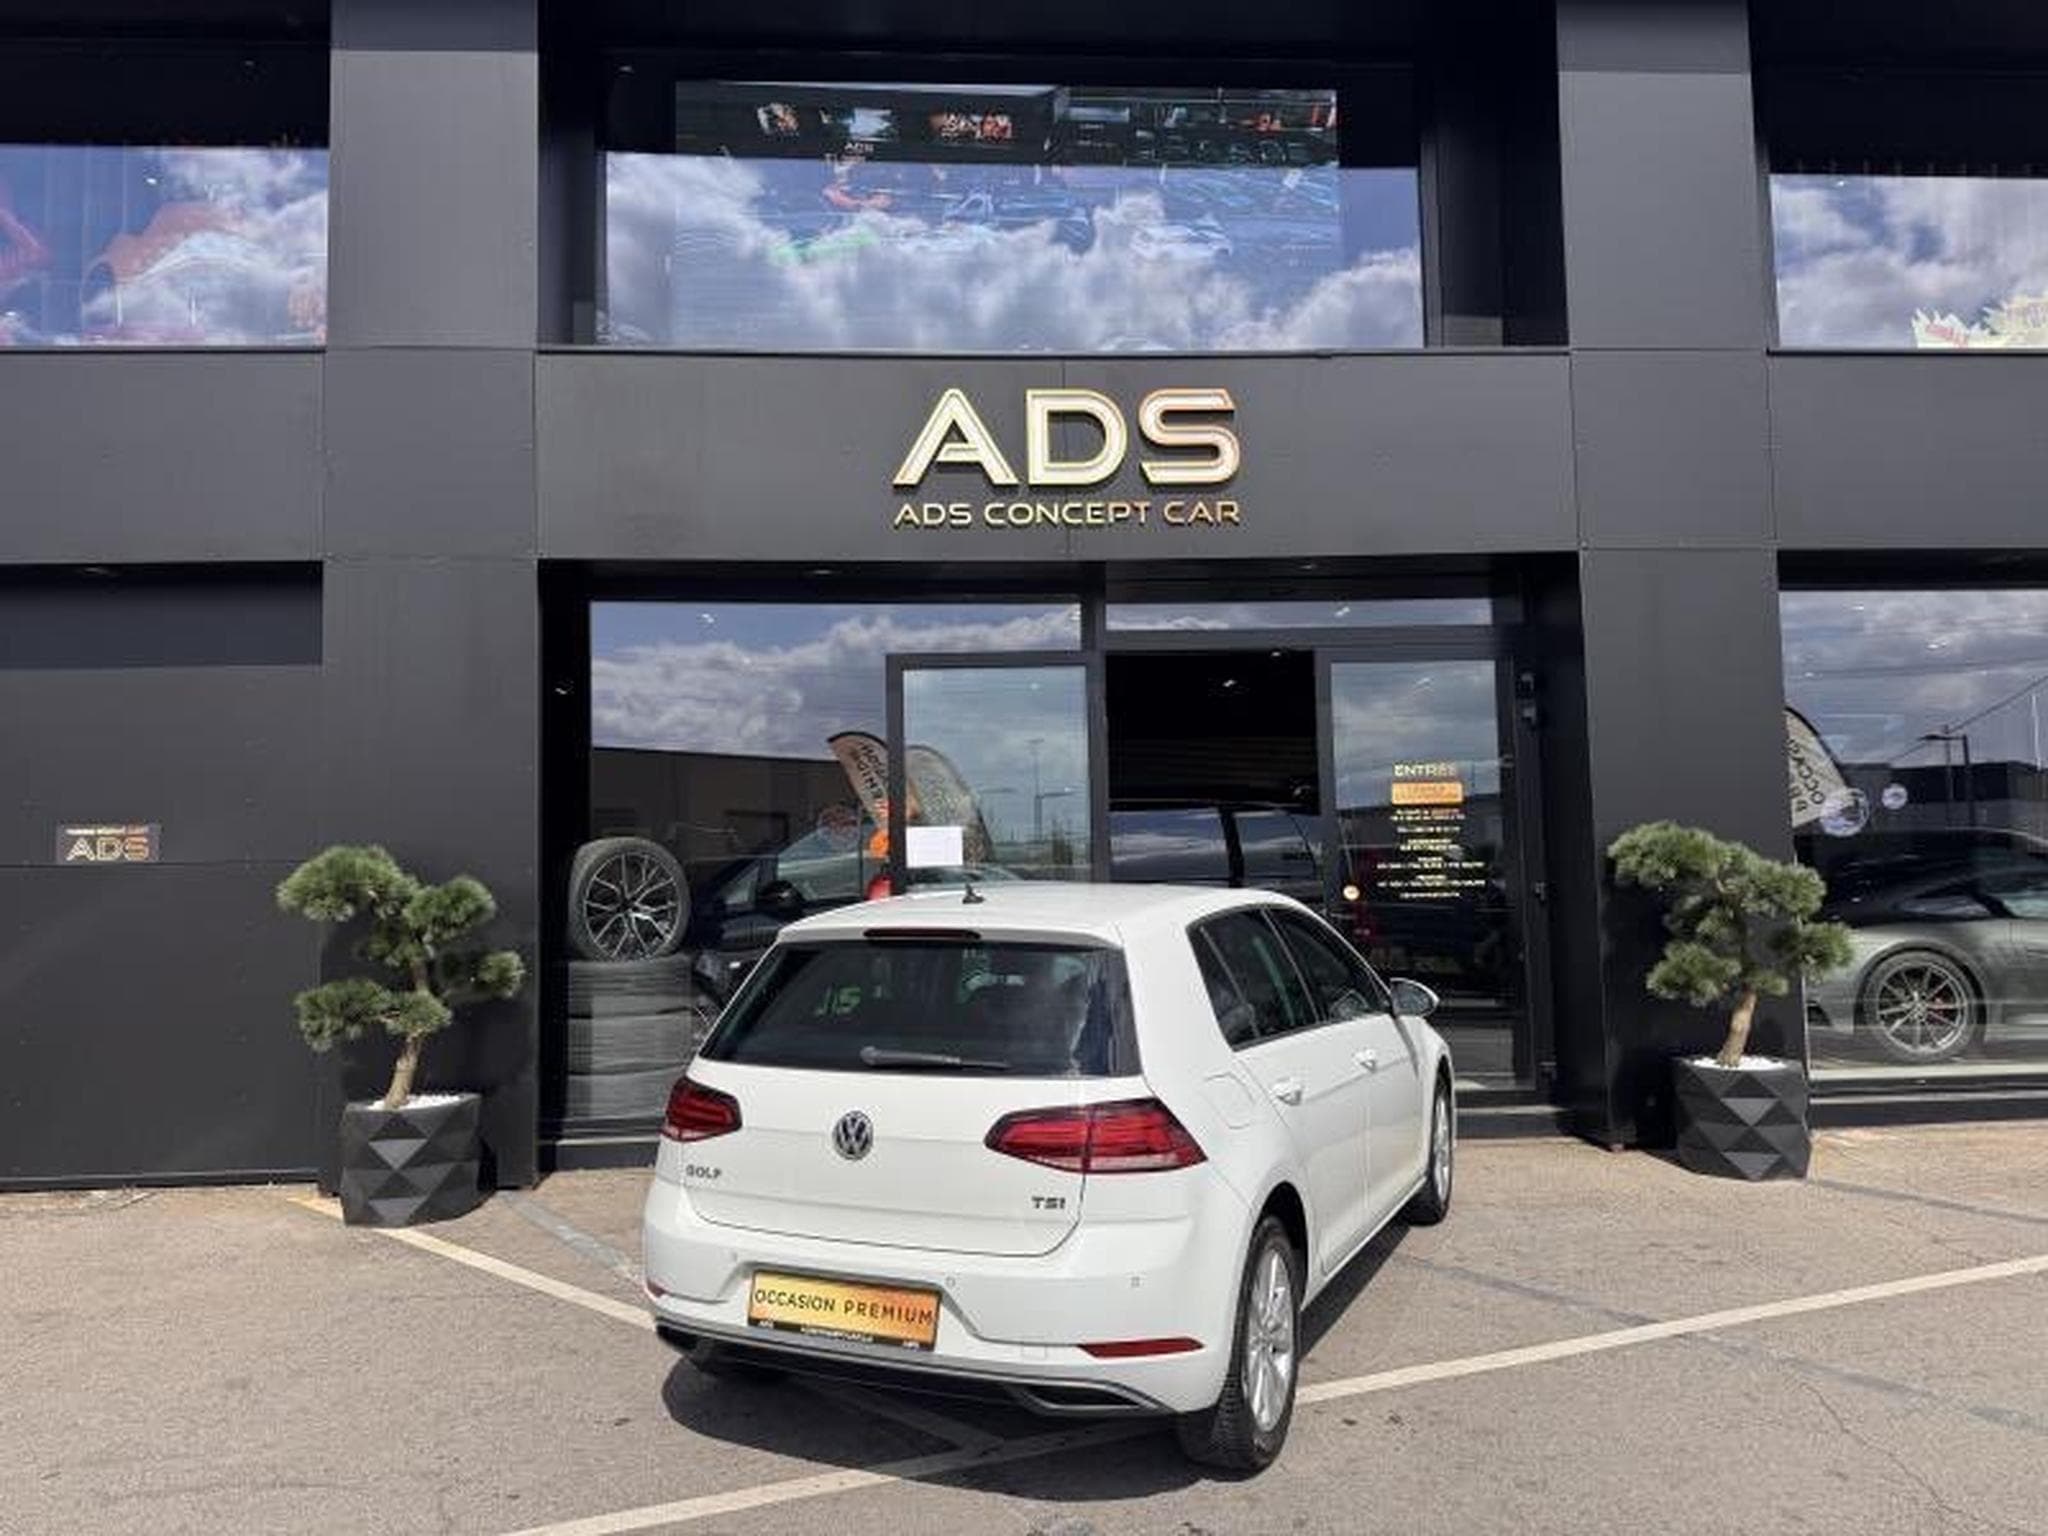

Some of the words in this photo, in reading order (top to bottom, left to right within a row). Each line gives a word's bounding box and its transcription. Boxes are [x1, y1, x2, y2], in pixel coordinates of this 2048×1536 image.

[892, 387, 1241, 486] ADS
[893, 502, 974, 526] ADS
[983, 501, 1151, 525] CONCEPT
[1163, 500, 1241, 524] CAR
[65, 836, 150, 862] ADS
[685, 1164, 723, 1180] GOLF
[1031, 1195, 1066, 1210] TSI
[754, 1289, 837, 1313] OCCASION
[843, 1299, 934, 1326] PREMIUM
